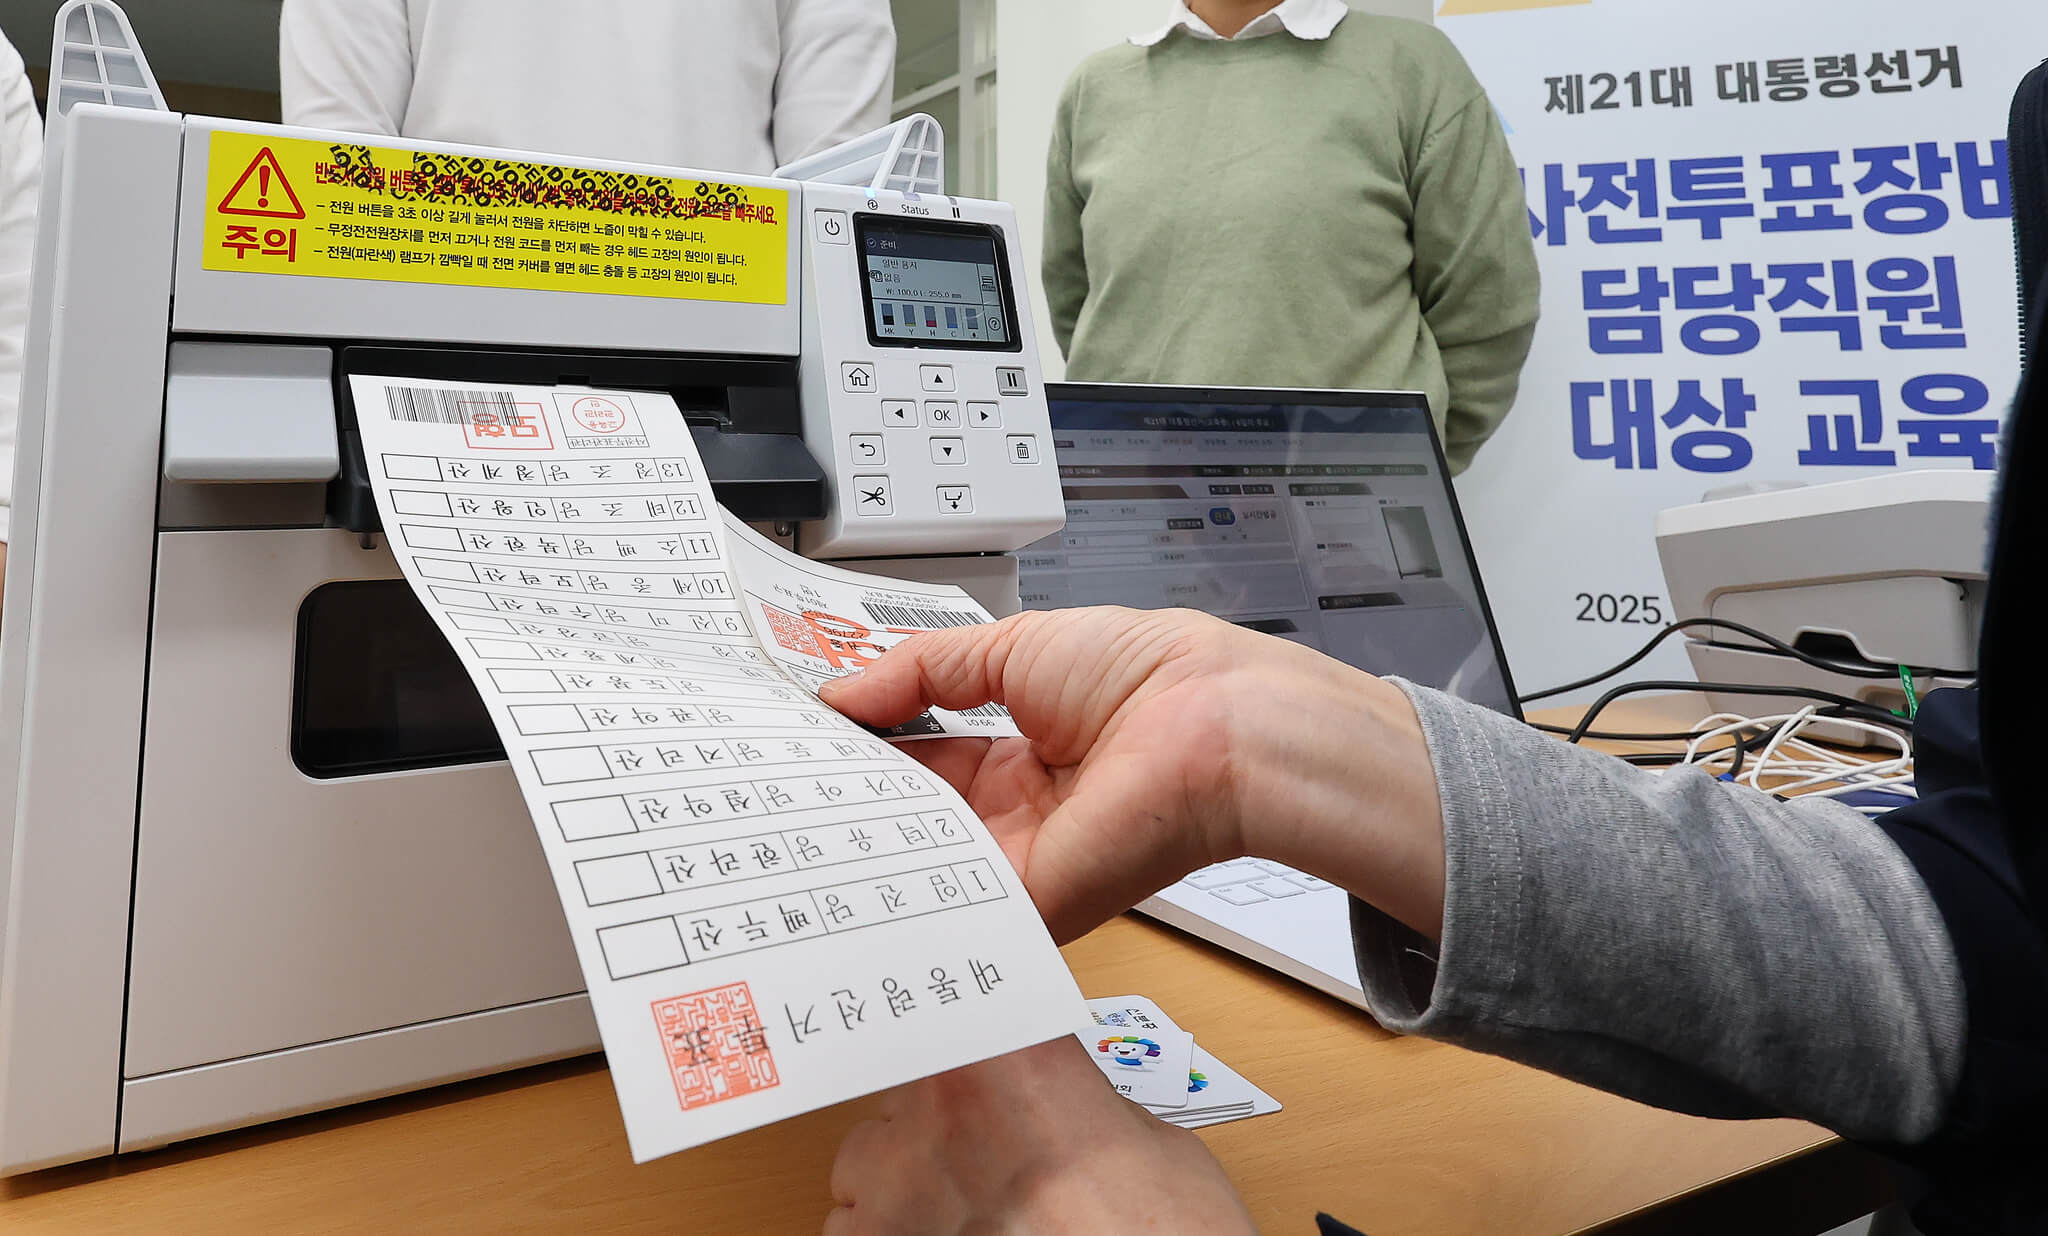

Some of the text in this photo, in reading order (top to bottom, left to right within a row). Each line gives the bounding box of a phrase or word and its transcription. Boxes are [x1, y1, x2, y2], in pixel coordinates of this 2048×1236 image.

[1543, 46, 1964, 114] 제21대 대통령선거
[329, 200, 707, 244] 전원 버튼을 3초 이상 길게 눌러서 전원을 차단하면 노즐이 막힐 수 있습니다.
[901, 204, 930, 216] Status
[221, 224, 297, 263] 주의
[327, 222, 748, 267] 무정전전원장치를 먼저 끄거나 전원 코드를 먼저 빼는 경우 헤드 고장의 원인이 됩니다.
[880, 240, 897, 250] 준비
[326, 244, 739, 286] 전원(파란색) 램프가 깜빡일 때 전면 커버를 열면 헤드 충돌 등 고장의 원인이 됩니다.
[882, 259, 918, 270] 일반 용지
[1581, 255, 1967, 356] 담당직원
[471, 411, 539, 438] 모형
[933, 409, 951, 422] OK
[1569, 373, 2000, 473] 대상 교육
[448, 461, 685, 482] 13 정조당 청계산
[456, 498, 700, 518] 12 태조당 인왕산
[469, 532, 711, 557] 11 소백당 북한산
[588, 574, 692, 595] 세종당
[701, 580, 724, 595] 10
[724, 616, 738, 632] 9
[590, 706, 696, 727] 관악산
[613, 743, 725, 771] 지리산
[638, 775, 921, 823] 3 가야당 설악산
[664, 818, 955, 883] 2 덕유당 한라산
[690, 869, 988, 951] 1 임진당 백두산
